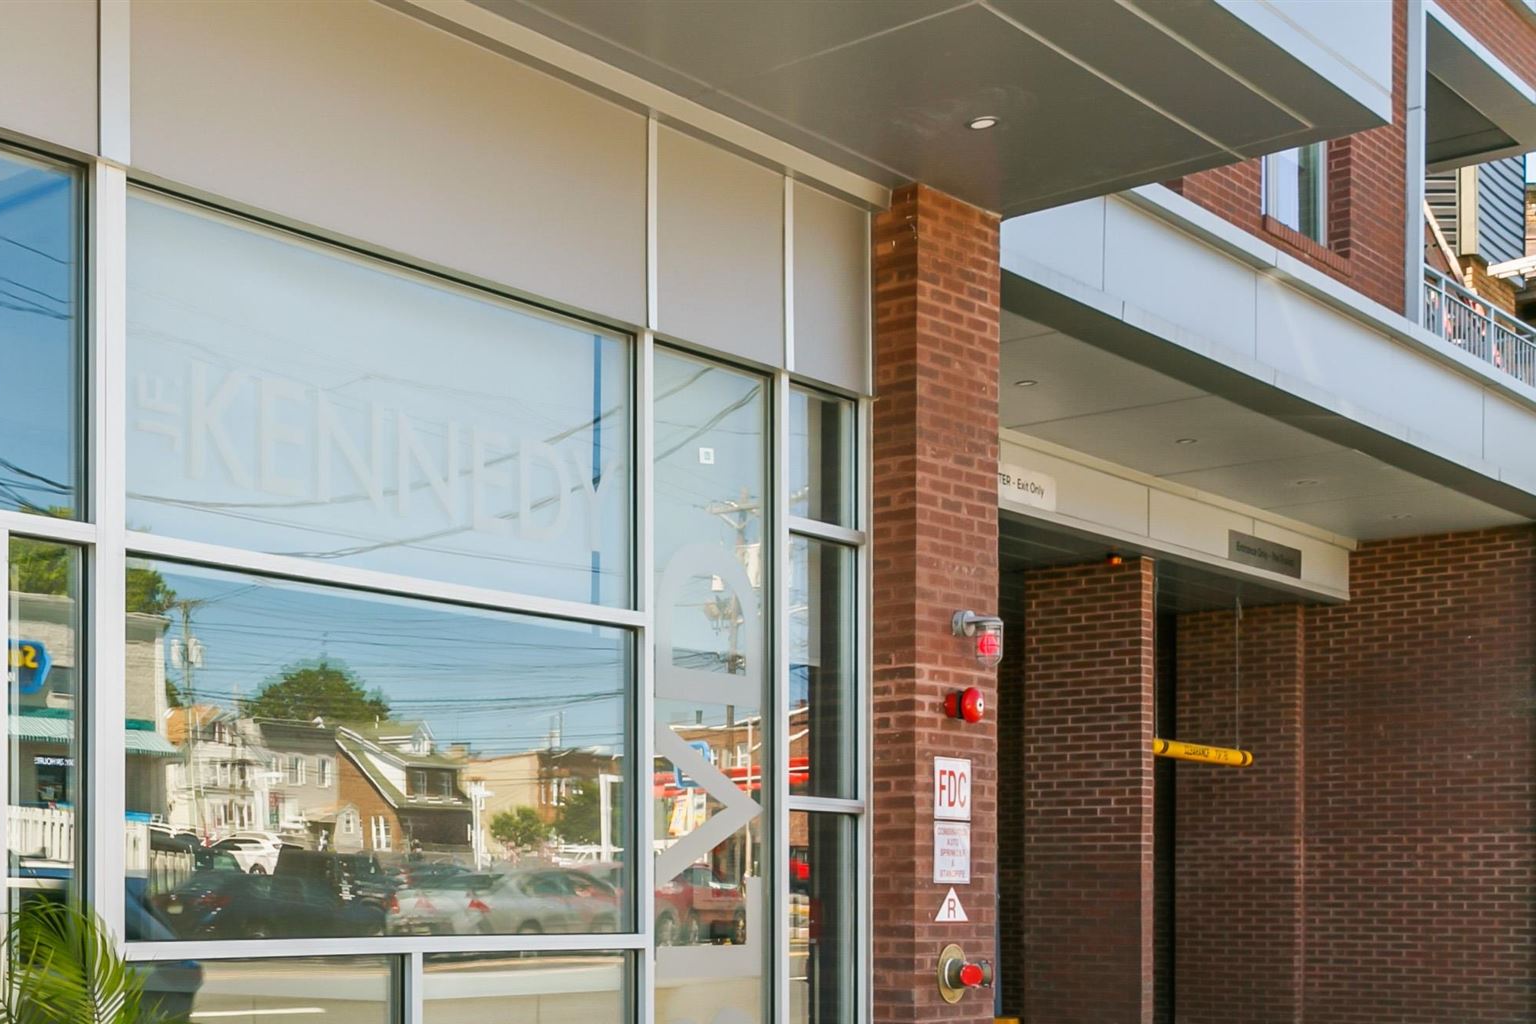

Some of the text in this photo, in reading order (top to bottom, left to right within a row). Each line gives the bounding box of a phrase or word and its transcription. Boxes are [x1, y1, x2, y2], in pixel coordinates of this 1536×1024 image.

[184, 360, 626, 554] KENNEDY
[1017, 478, 1029, 492] Exit
[1030, 482, 1045, 499] Only
[939, 769, 967, 808] FDC
[947, 898, 956, 919] R
